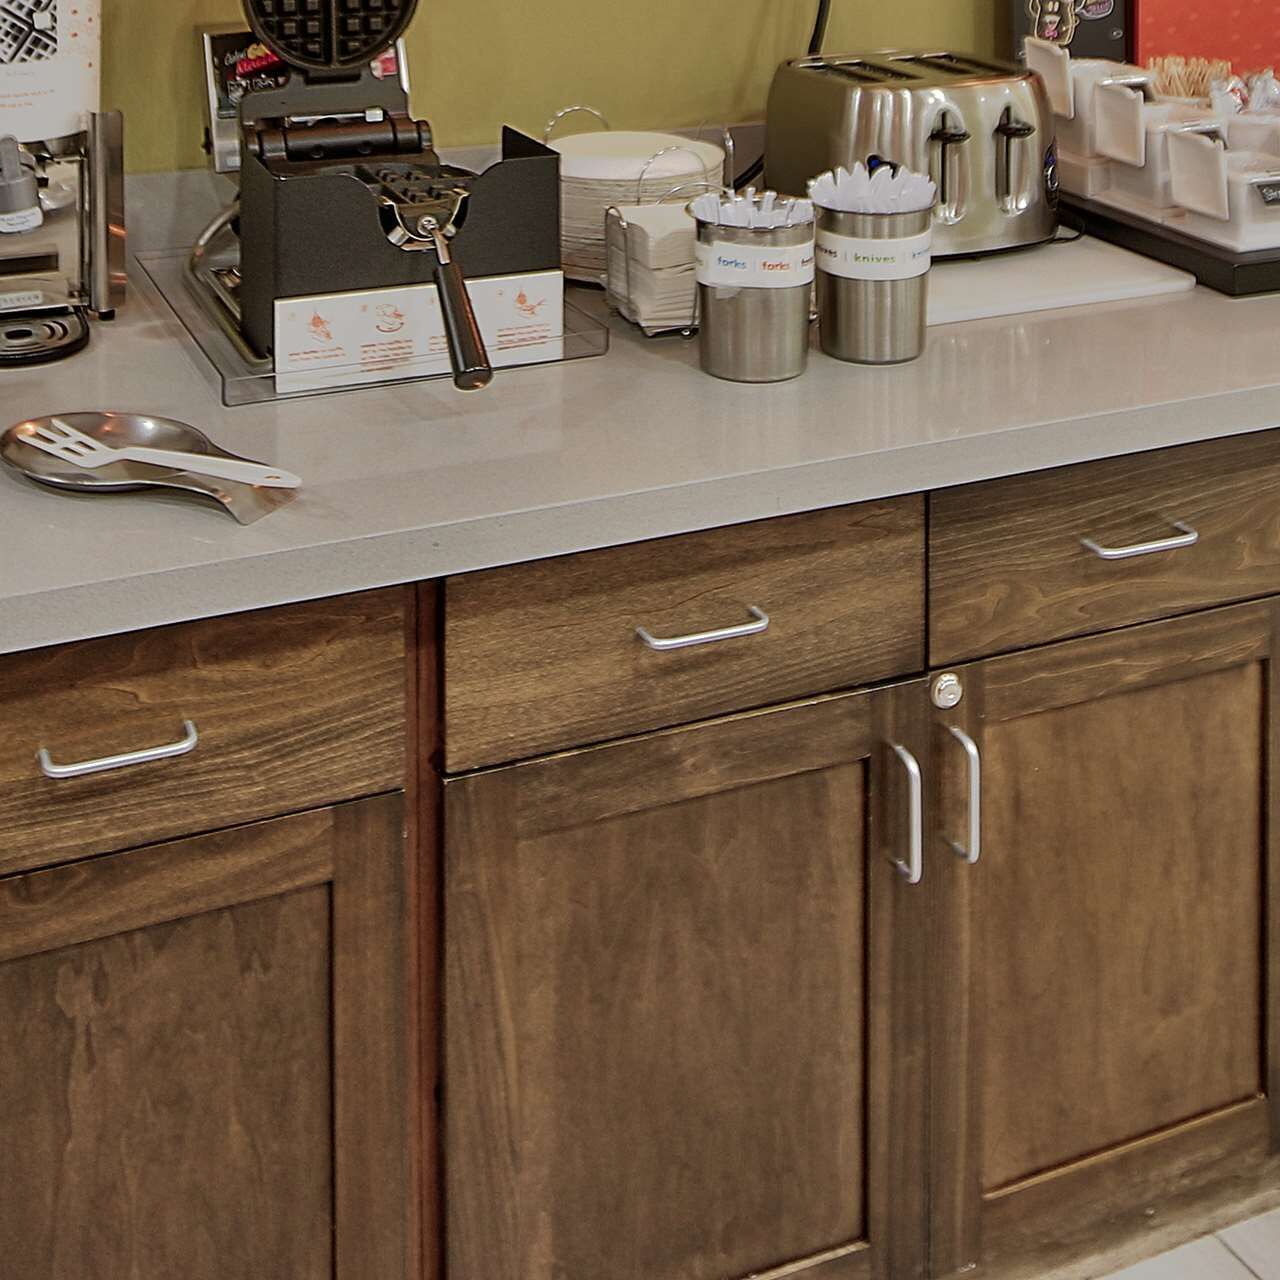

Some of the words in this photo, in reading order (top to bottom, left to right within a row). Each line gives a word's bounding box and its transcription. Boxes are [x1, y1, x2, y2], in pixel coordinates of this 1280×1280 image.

[717, 255, 747, 269] forks
[853, 252, 896, 265] knives
[761, 260, 791, 271] forks
